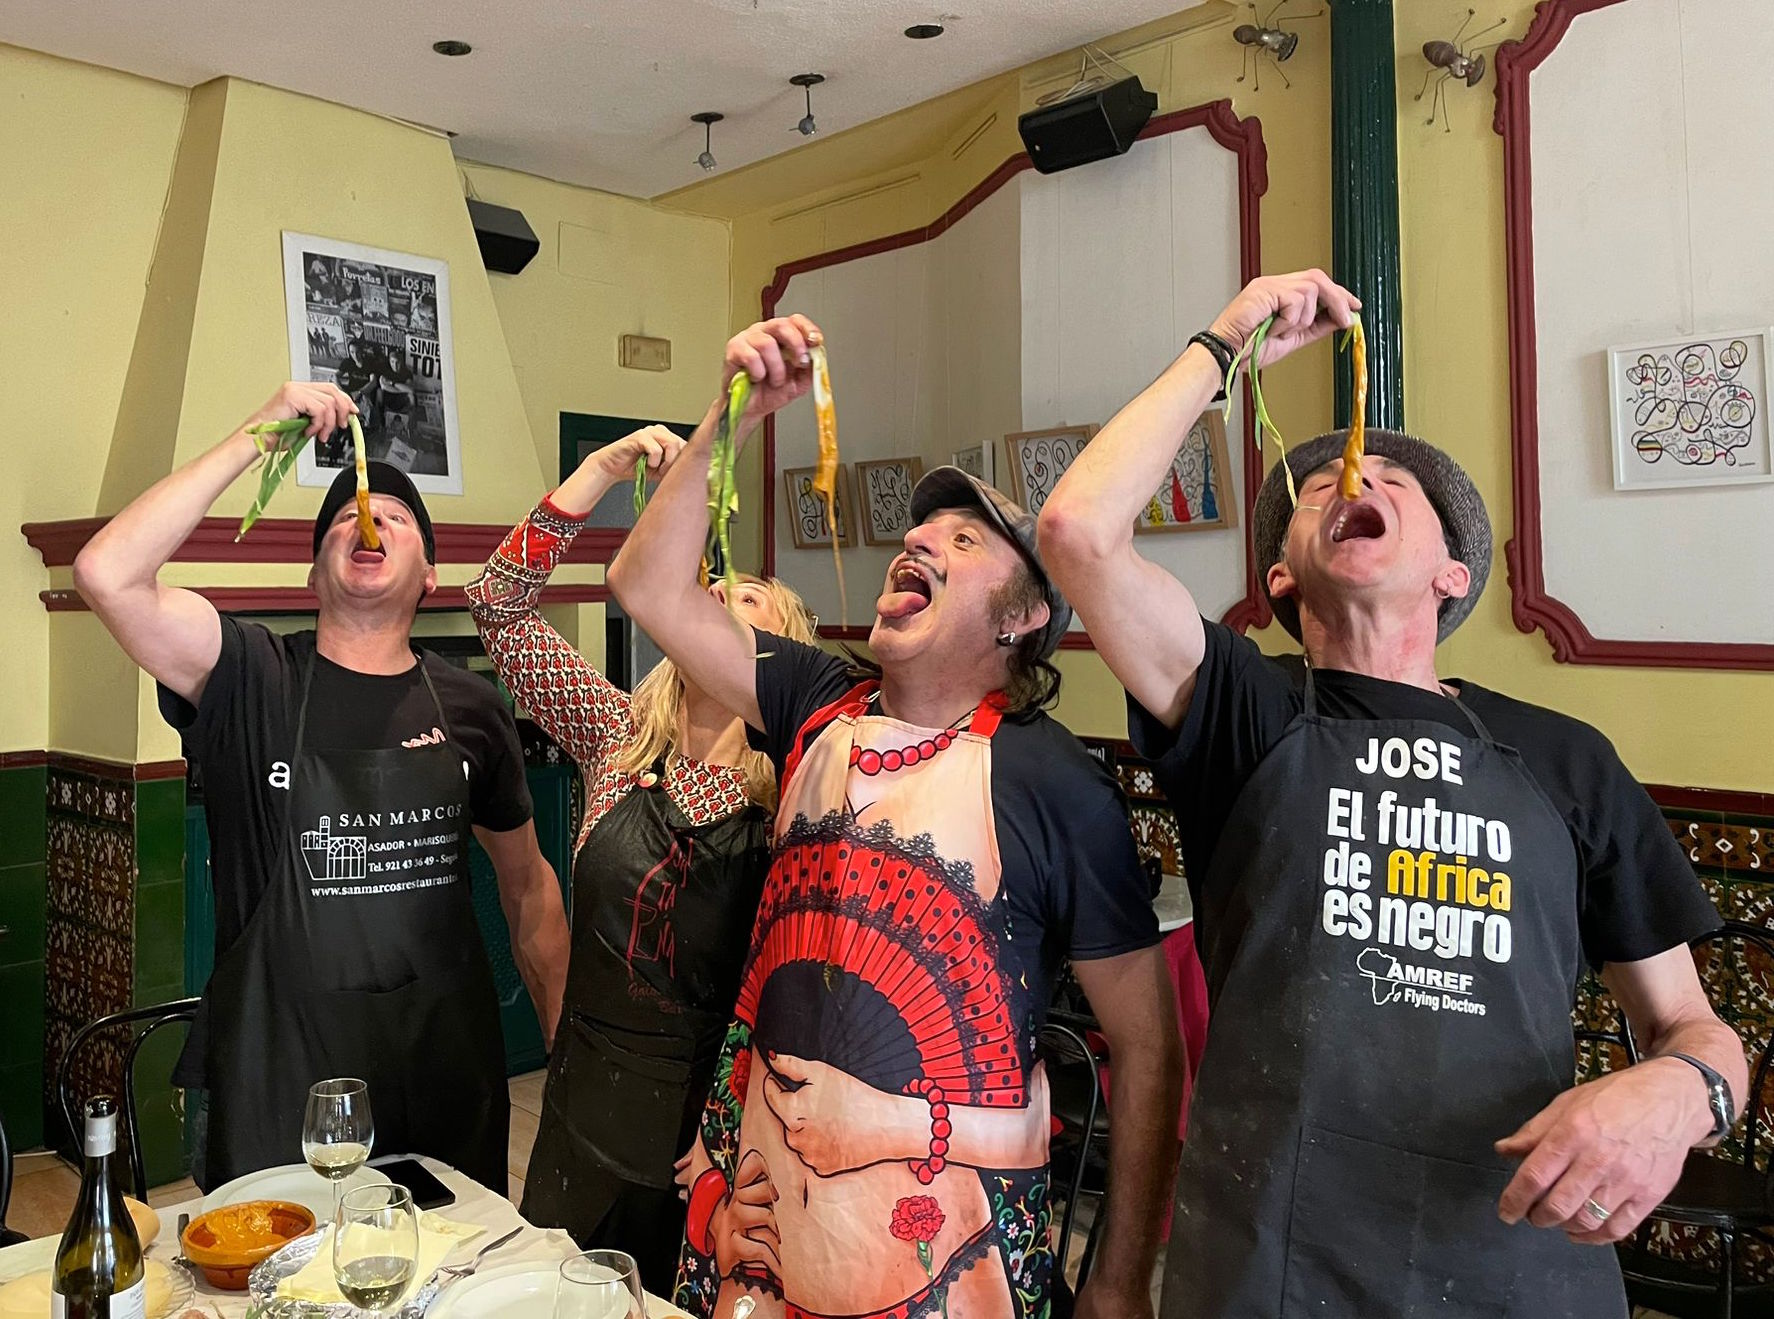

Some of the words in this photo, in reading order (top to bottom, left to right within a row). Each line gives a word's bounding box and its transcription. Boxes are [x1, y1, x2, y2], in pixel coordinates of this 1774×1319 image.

[402, 273, 419, 291] LOS
[421, 280, 435, 293] EN
[1355, 737, 1463, 786] JOSE
[339, 812, 382, 828] SAN
[389, 804, 462, 826] MARCOS
[1326, 787, 1366, 841] El
[1377, 790, 1513, 863] futuro
[367, 840, 405, 853] ASADOR
[368, 861, 384, 873] Tel.
[385, 859, 401, 871] 921
[402, 858, 413, 870] 43
[424, 855, 435, 866] 49
[1323, 841, 1372, 891] de
[1387, 848, 1512, 912] Africa
[1322, 889, 1373, 941] es
[1377, 896, 1512, 964] negro
[1386, 963, 1474, 991] AMREF
[1404, 987, 1440, 1012] Flying
[1442, 993, 1486, 1016] Doctors
